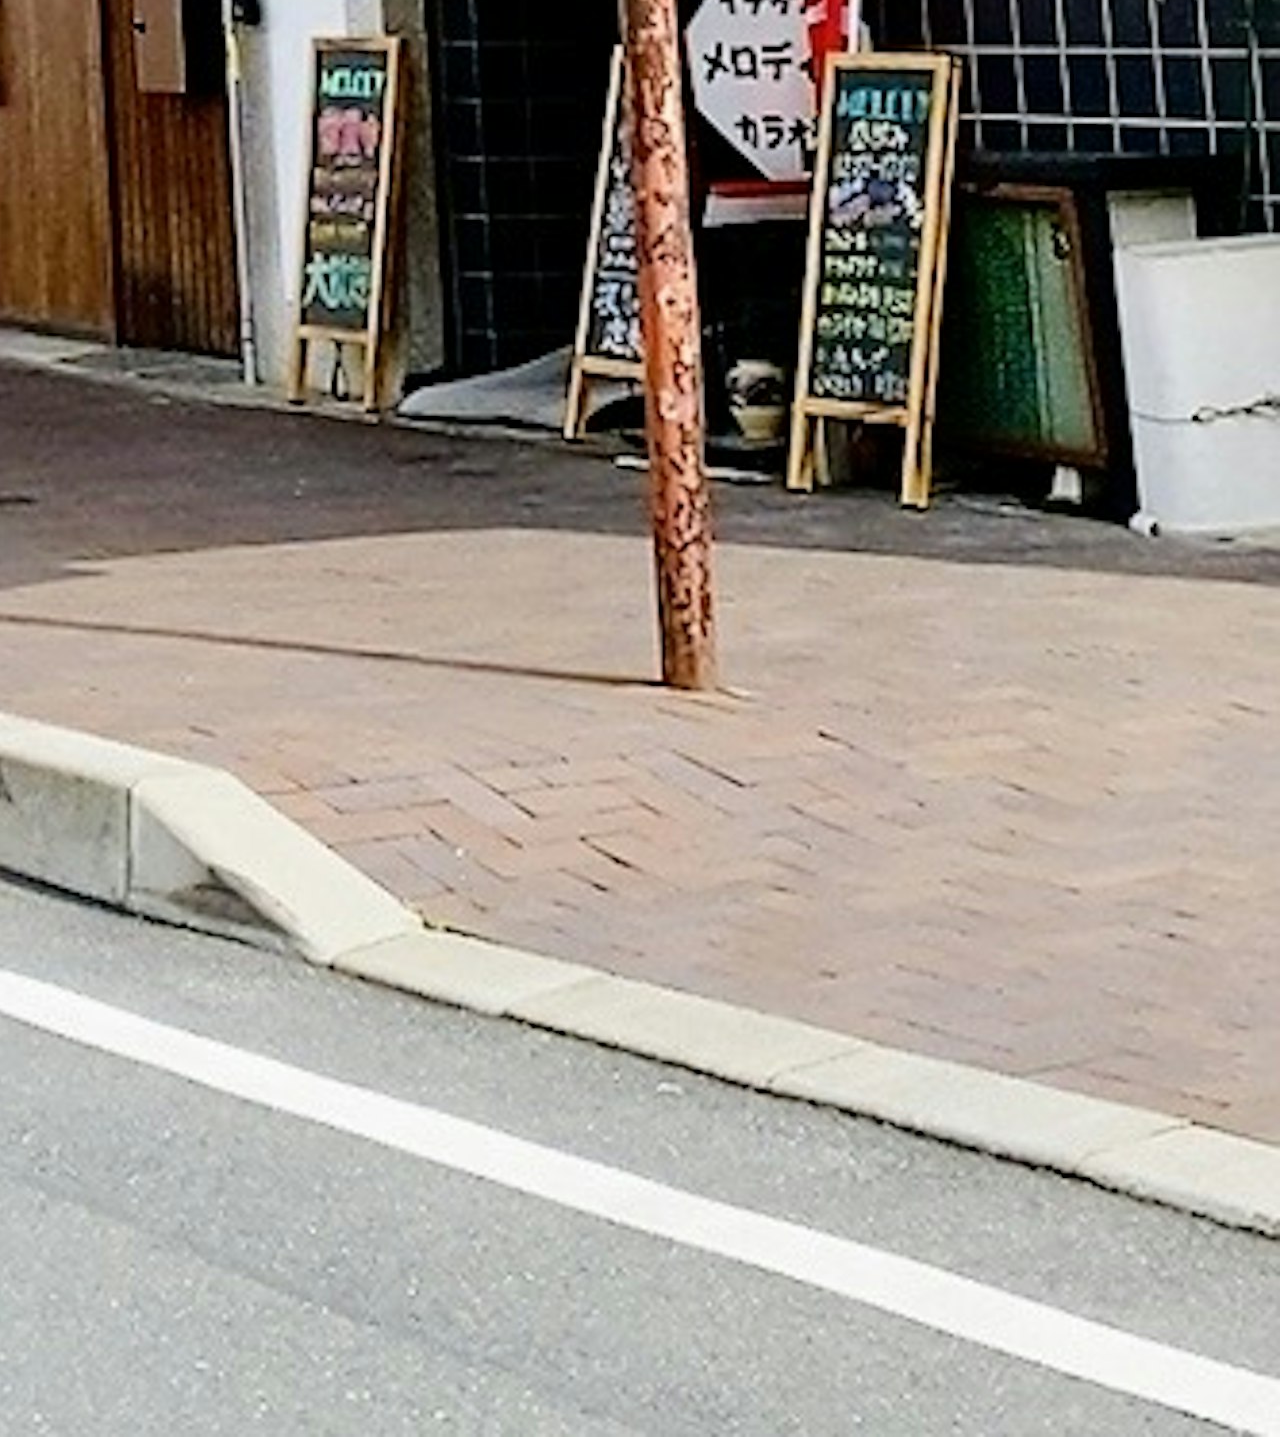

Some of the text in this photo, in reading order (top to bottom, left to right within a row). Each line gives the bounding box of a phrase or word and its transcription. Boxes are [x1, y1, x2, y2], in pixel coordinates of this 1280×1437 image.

[703, 42, 816, 84] メロディ
[734, 115, 818, 149] カラオ
